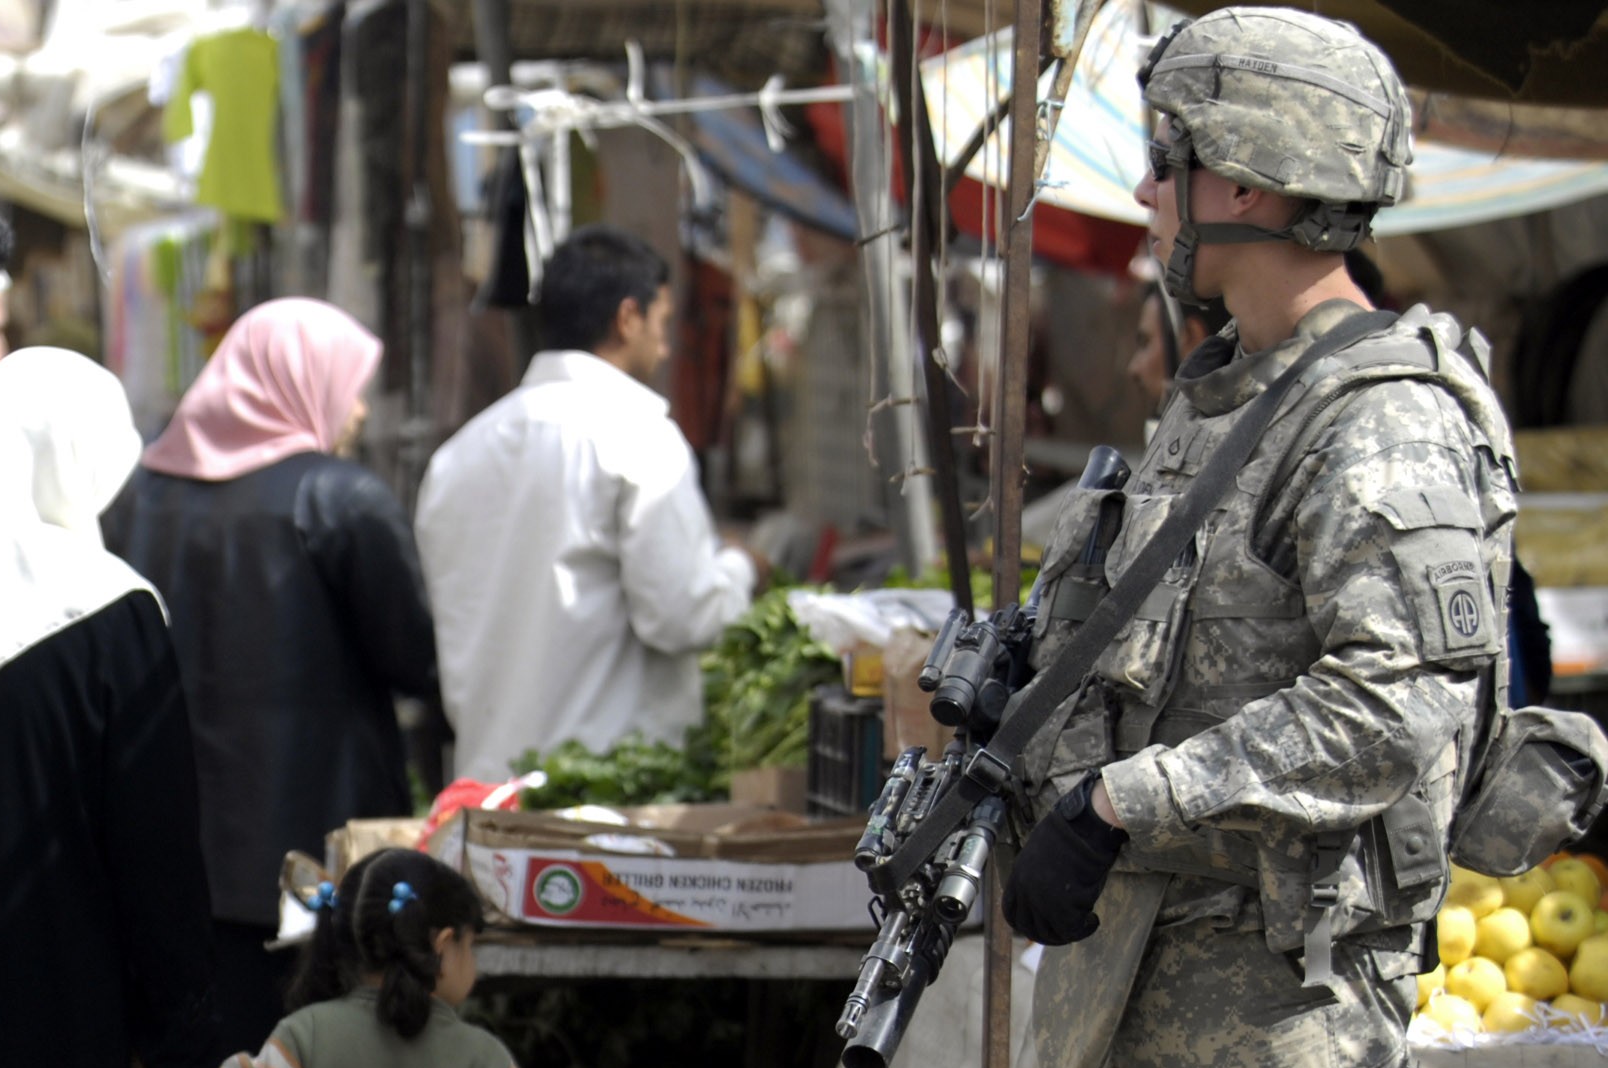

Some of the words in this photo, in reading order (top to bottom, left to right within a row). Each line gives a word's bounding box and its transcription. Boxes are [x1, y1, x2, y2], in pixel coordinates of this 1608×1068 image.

[1239, 58, 1278, 74] HAYDEN
[668, 874, 732, 891] CHICKEN
[736, 878, 793, 893] FROZEN
